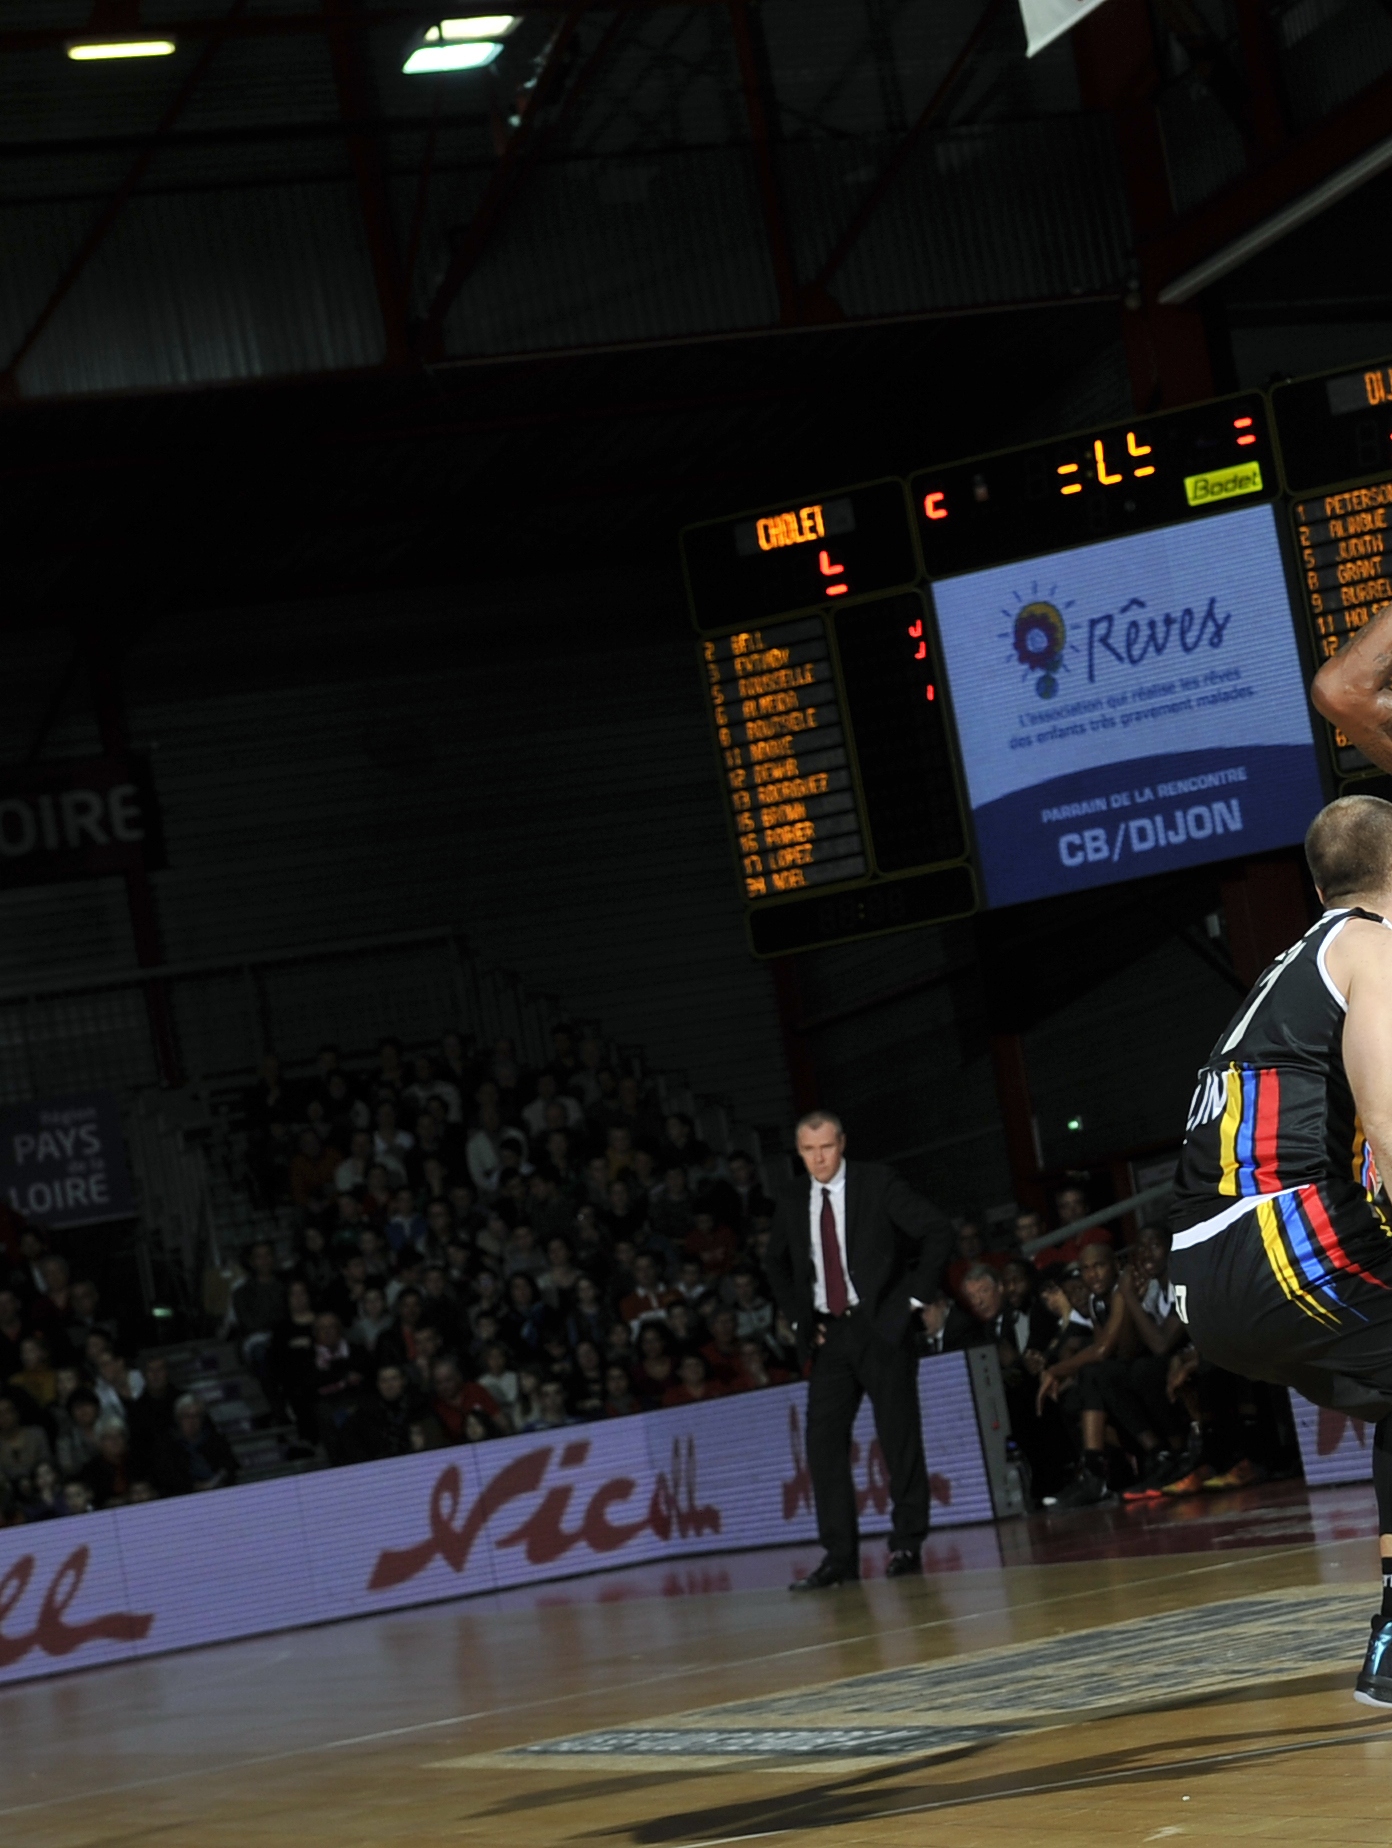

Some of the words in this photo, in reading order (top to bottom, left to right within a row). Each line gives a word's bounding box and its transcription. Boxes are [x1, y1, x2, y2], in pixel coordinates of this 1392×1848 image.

[1193, 471, 1260, 501] Bodet
[756, 504, 825, 551] CHOLET
[1298, 525, 1311, 546] 2
[1303, 548, 1316, 569] 5
[1337, 556, 1382, 584] GRANT
[1311, 593, 1324, 614] 9
[1088, 597, 1232, 683] Rêves
[1037, 723, 1087, 743] enfants
[1120, 700, 1192, 728] gravement
[1041, 797, 1108, 824] PARRAIN
[1110, 792, 1132, 809] DE
[1134, 787, 1155, 803] LA
[1156, 766, 1248, 798] RENCONTRE
[0, 783, 146, 857] OIRE
[1058, 798, 1244, 867] CB/DIJON
[12, 1122, 102, 1165] PAYS
[8, 1172, 110, 1217] LOIRE
[367, 1434, 722, 1592] Nicoll
